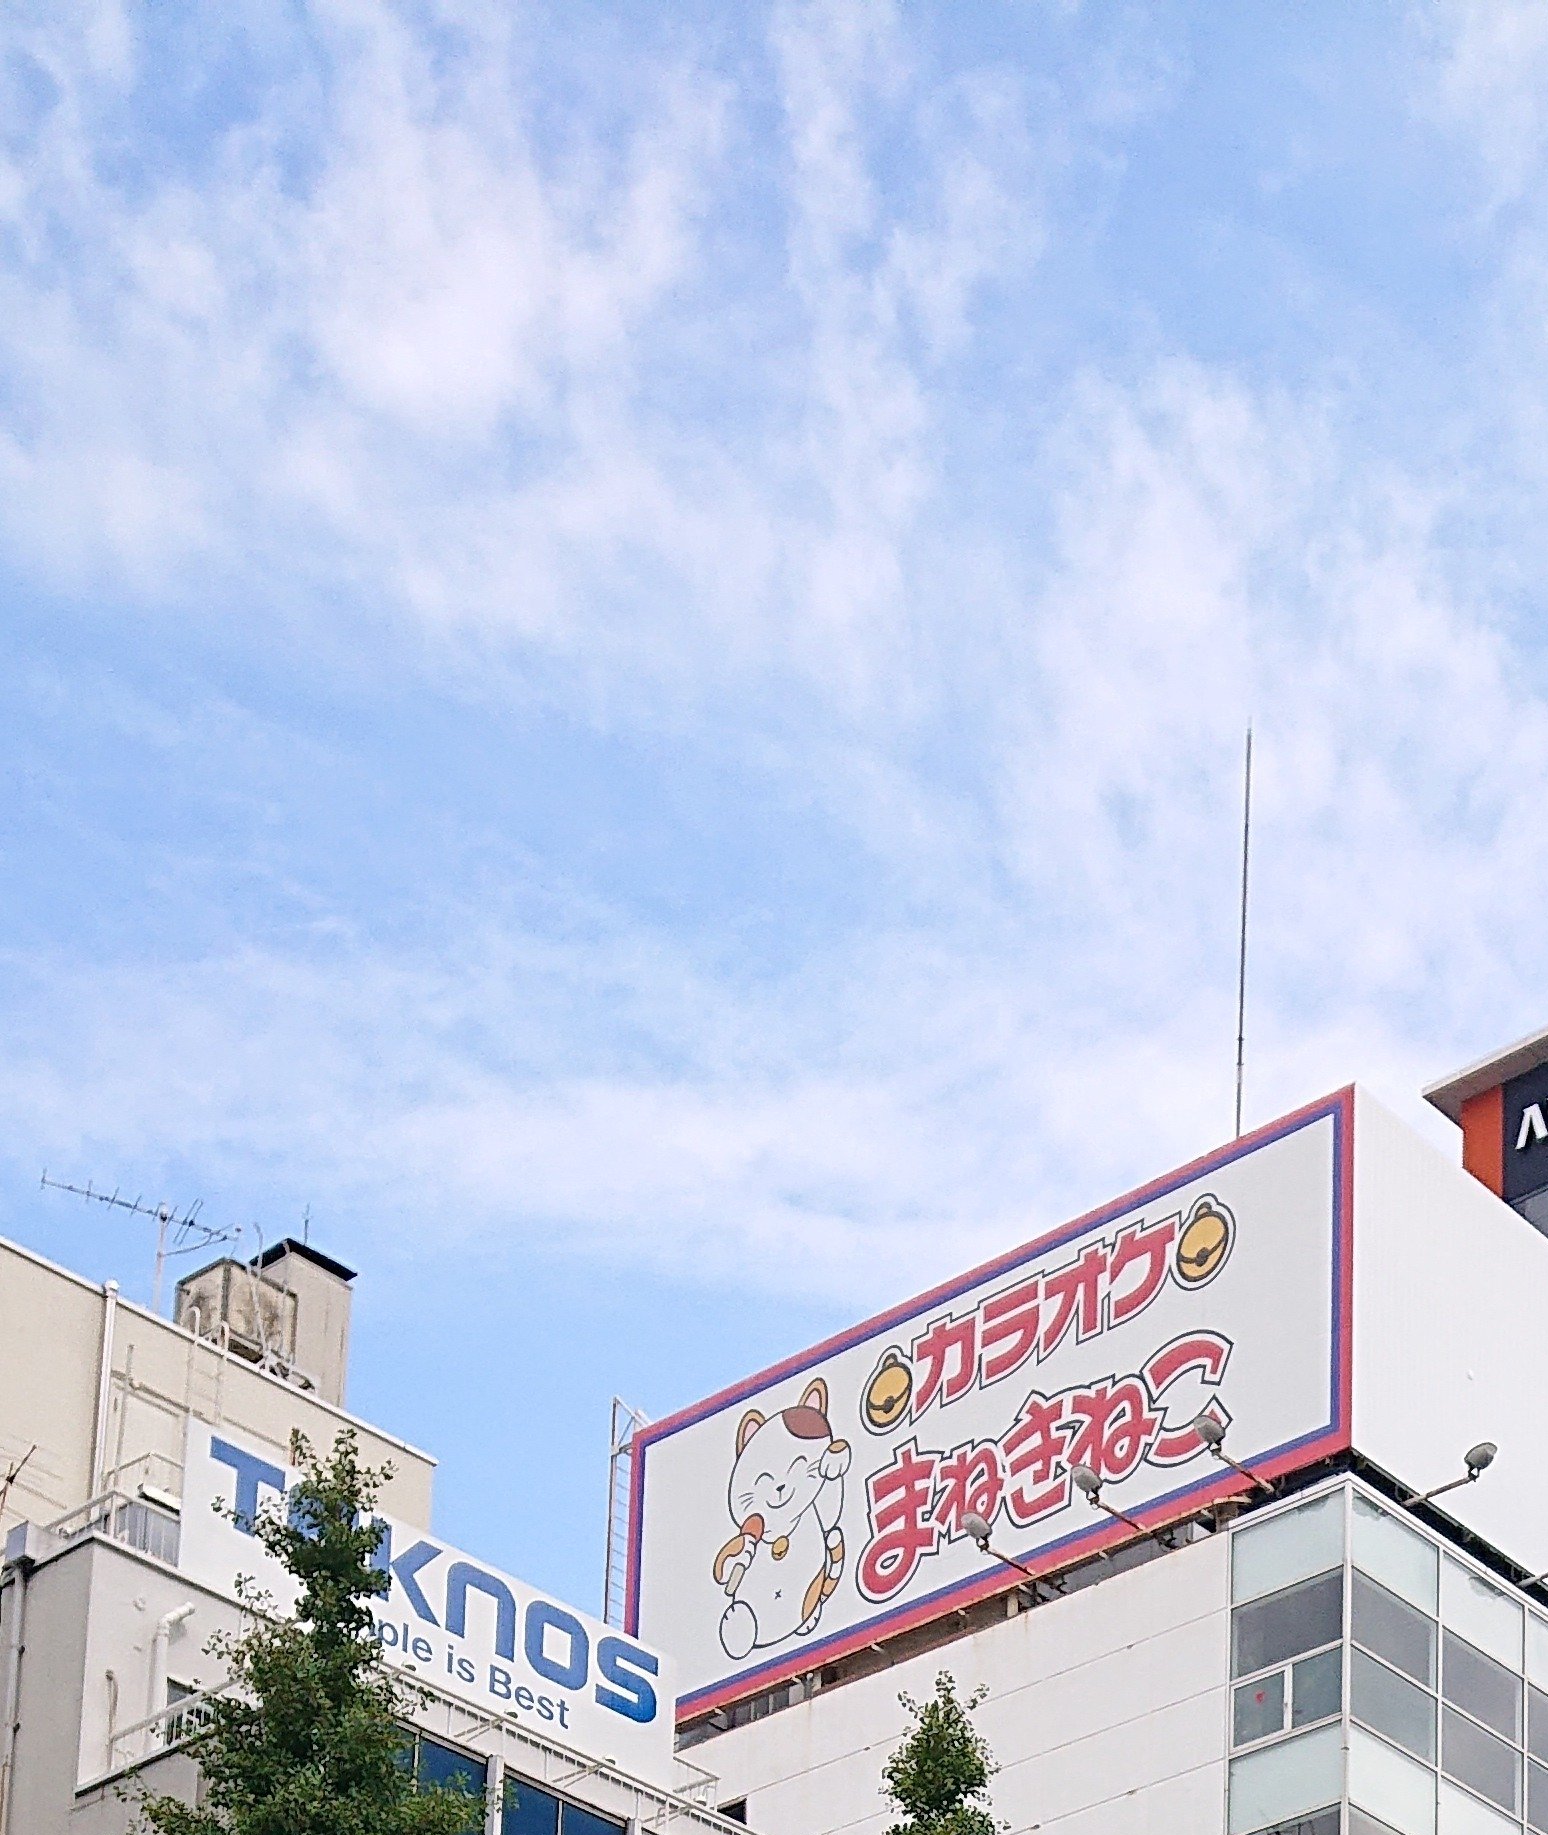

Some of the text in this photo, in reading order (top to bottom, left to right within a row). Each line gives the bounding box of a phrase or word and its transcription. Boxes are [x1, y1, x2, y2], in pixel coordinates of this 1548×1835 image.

[911, 1218, 1176, 1414] カラオケ
[857, 1331, 1234, 1604] まねきねこ
[447, 1645, 476, 1683] is
[489, 1664, 571, 1731] Best
